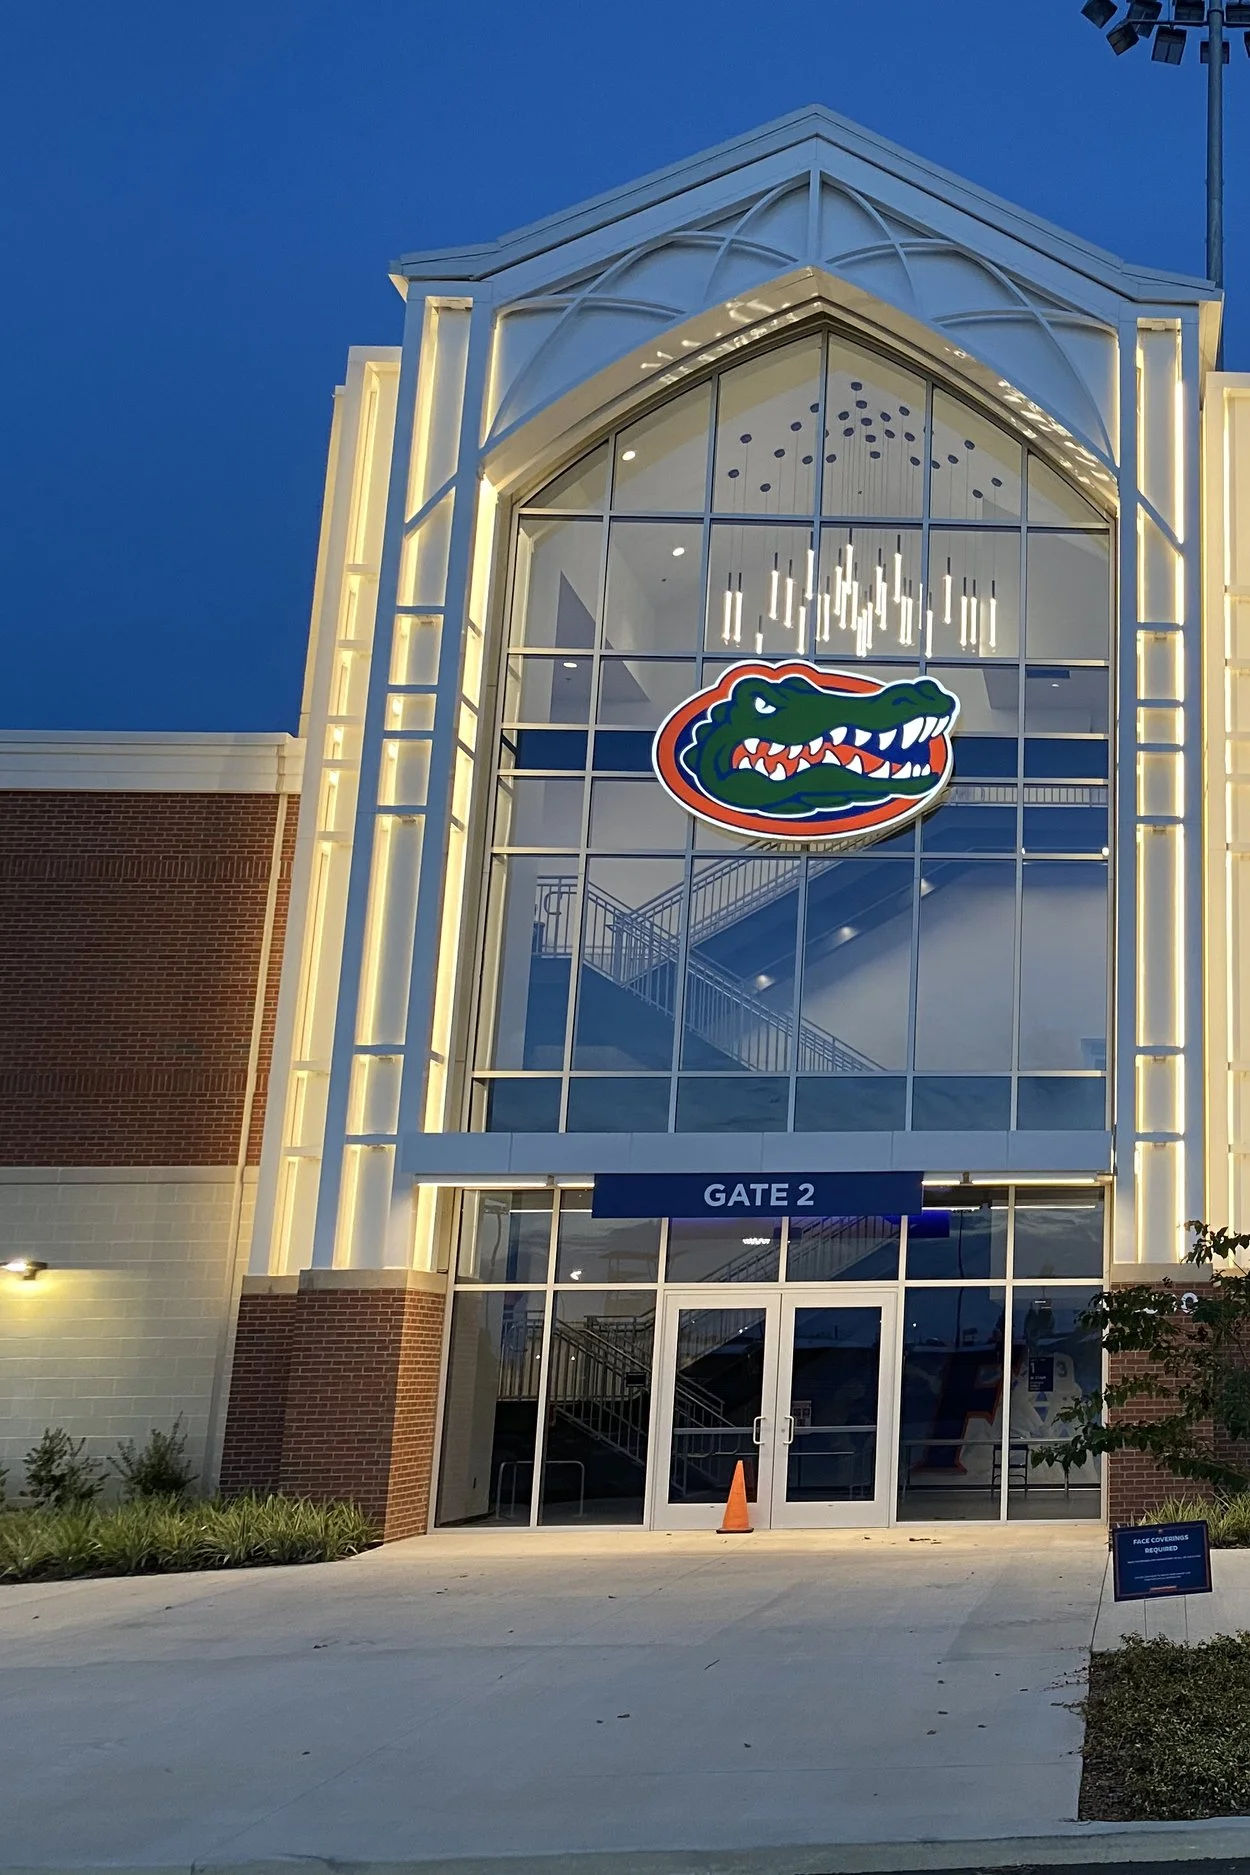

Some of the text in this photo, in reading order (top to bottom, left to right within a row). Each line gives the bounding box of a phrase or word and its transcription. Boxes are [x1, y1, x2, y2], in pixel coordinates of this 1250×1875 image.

[703, 1183, 815, 1207] GATE 2
[1150, 1534, 1189, 1543] COVERINGS
[1144, 1545, 1178, 1554] REQUIRED
